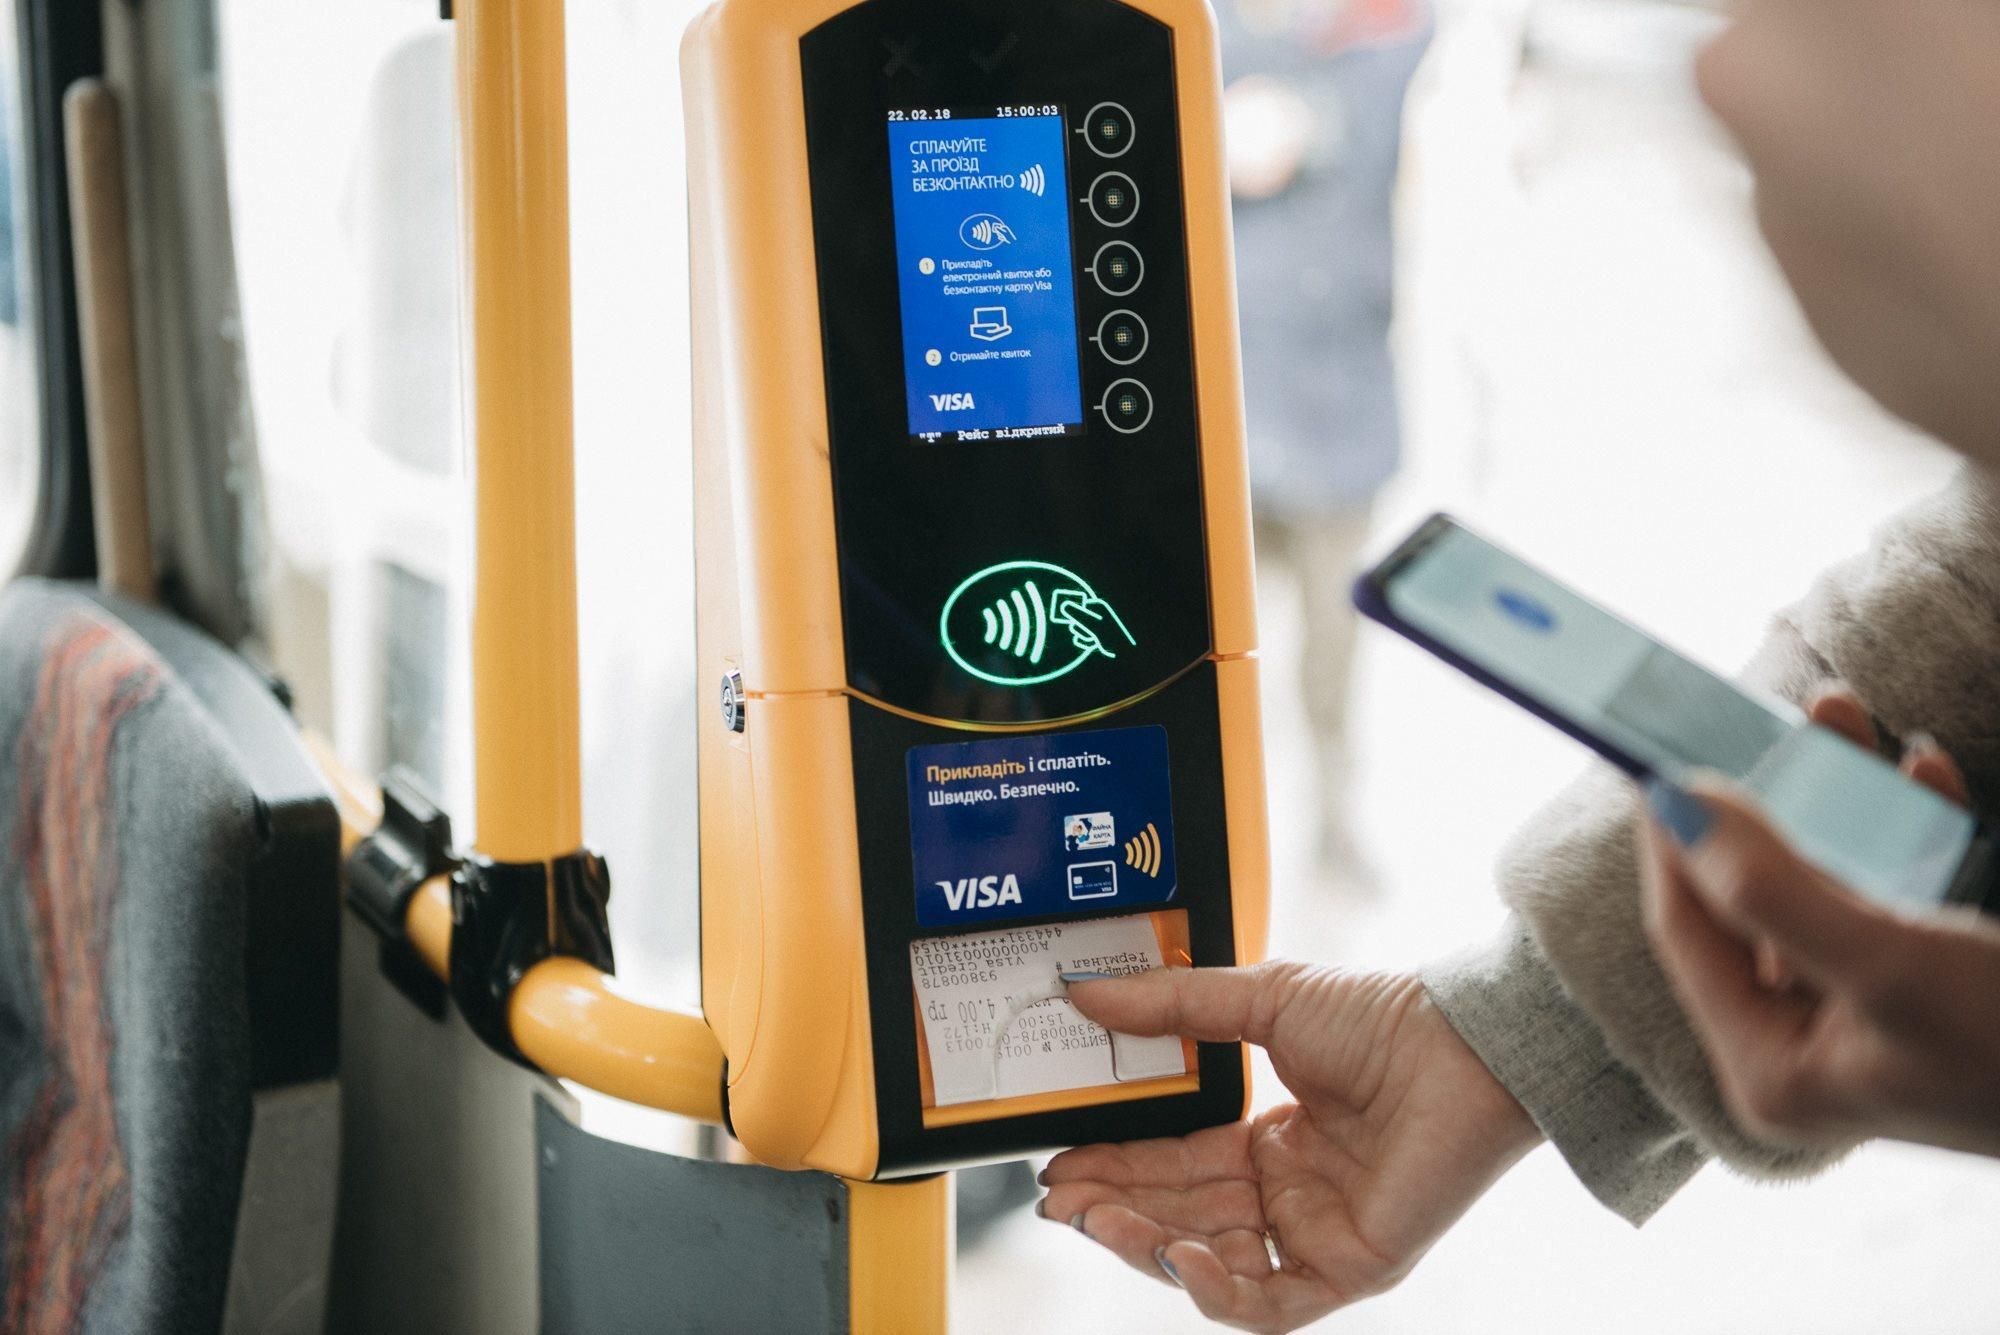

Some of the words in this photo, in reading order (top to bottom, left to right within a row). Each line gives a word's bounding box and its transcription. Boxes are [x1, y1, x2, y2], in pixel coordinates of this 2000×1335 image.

[888, 109, 951, 121] 22.02.18
[996, 105, 1058, 118] 15:00:03
[910, 137, 987, 155] СПЛАЧУЙТЕ
[911, 160, 928, 174] ЗА
[931, 157, 980, 174] ПРОЇЗД
[913, 174, 1014, 192] БЕЗКОНТАКТНО
[942, 259, 993, 272] Прикладіть
[943, 271, 1002, 283] електронний
[1003, 271, 1034, 279] квиток
[1035, 268, 1052, 278] або
[944, 284, 1003, 296] безконтактну
[1005, 283, 1034, 293] картку
[1035, 280, 1052, 291] Visa
[950, 350, 1000, 363] Отримайте
[1001, 349, 1031, 359] квиток
[928, 393, 975, 412] VISA
[958, 429, 990, 441] Рейс
[996, 423, 1065, 439] відкритий
[926, 760, 1026, 785] Прикладіть
[1028, 757, 1034, 773] і
[1038, 751, 1112, 773] сплатіть.
[928, 789, 998, 807] Швидко.
[1000, 781, 1080, 800] Безпечно.
[935, 873, 1023, 912] VISA
[917, 961, 978, 977] Credit
[986, 956, 1024, 969] Visa
[1072, 952, 1148, 969] Термінал
[921, 970, 997, 990] 93800878
[1060, 1034, 1110, 1050] ВИТОК
